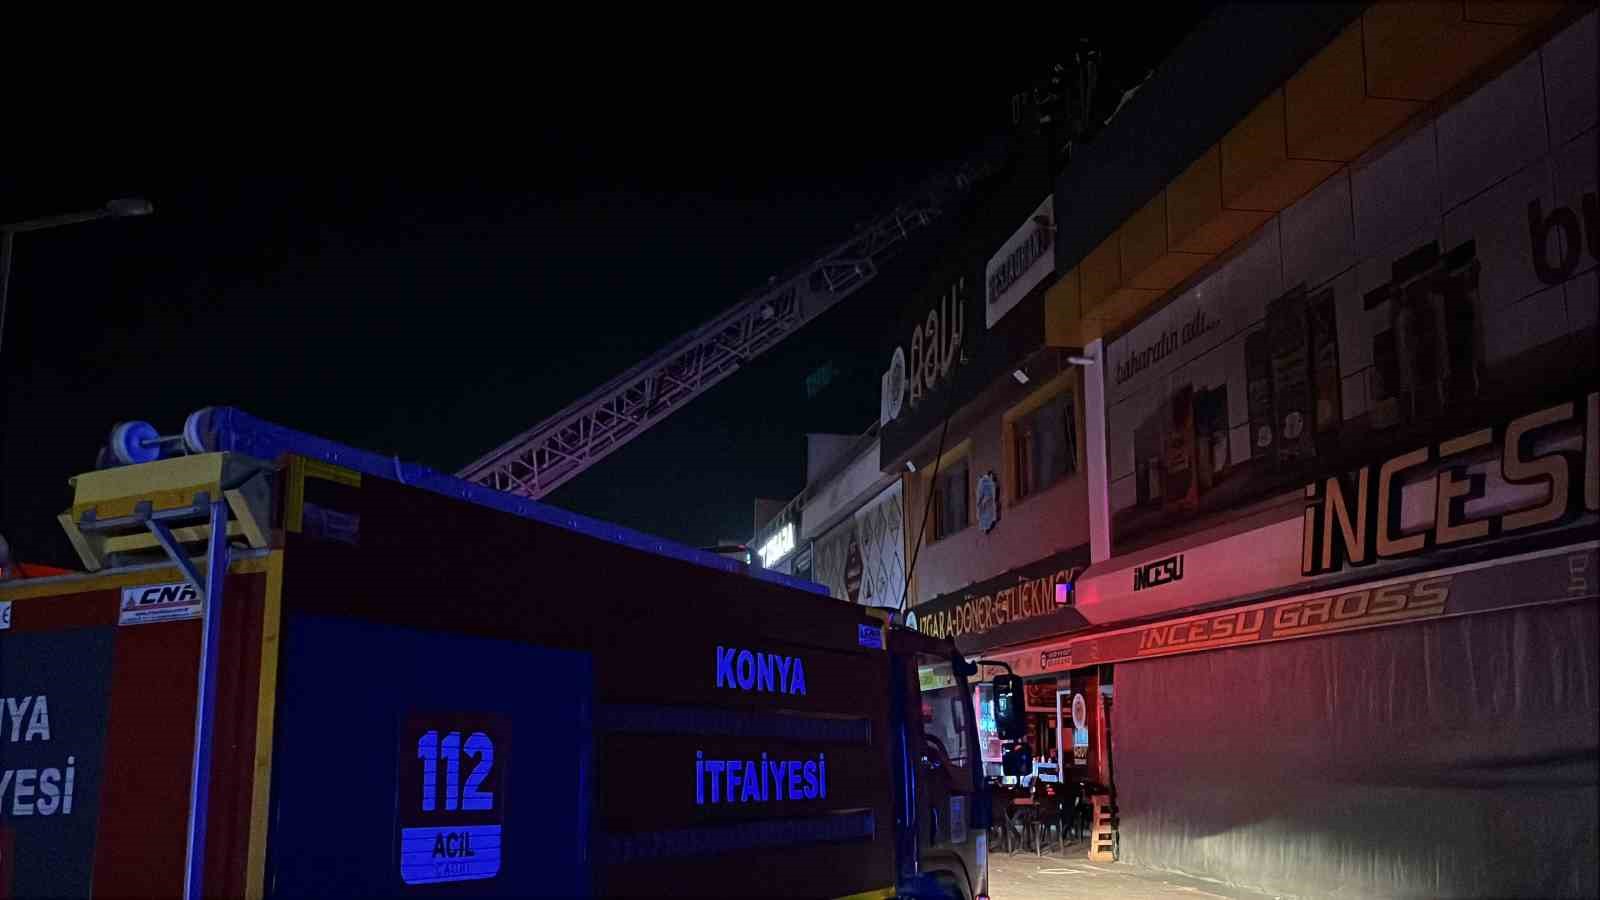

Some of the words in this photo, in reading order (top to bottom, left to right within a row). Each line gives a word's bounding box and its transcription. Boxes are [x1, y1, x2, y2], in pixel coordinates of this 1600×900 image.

[1272, 575, 1457, 632] GROSS
[715, 644, 807, 697] KONYA
[416, 730, 495, 811] 112
[695, 750, 827, 806] İTFAİYESİ
